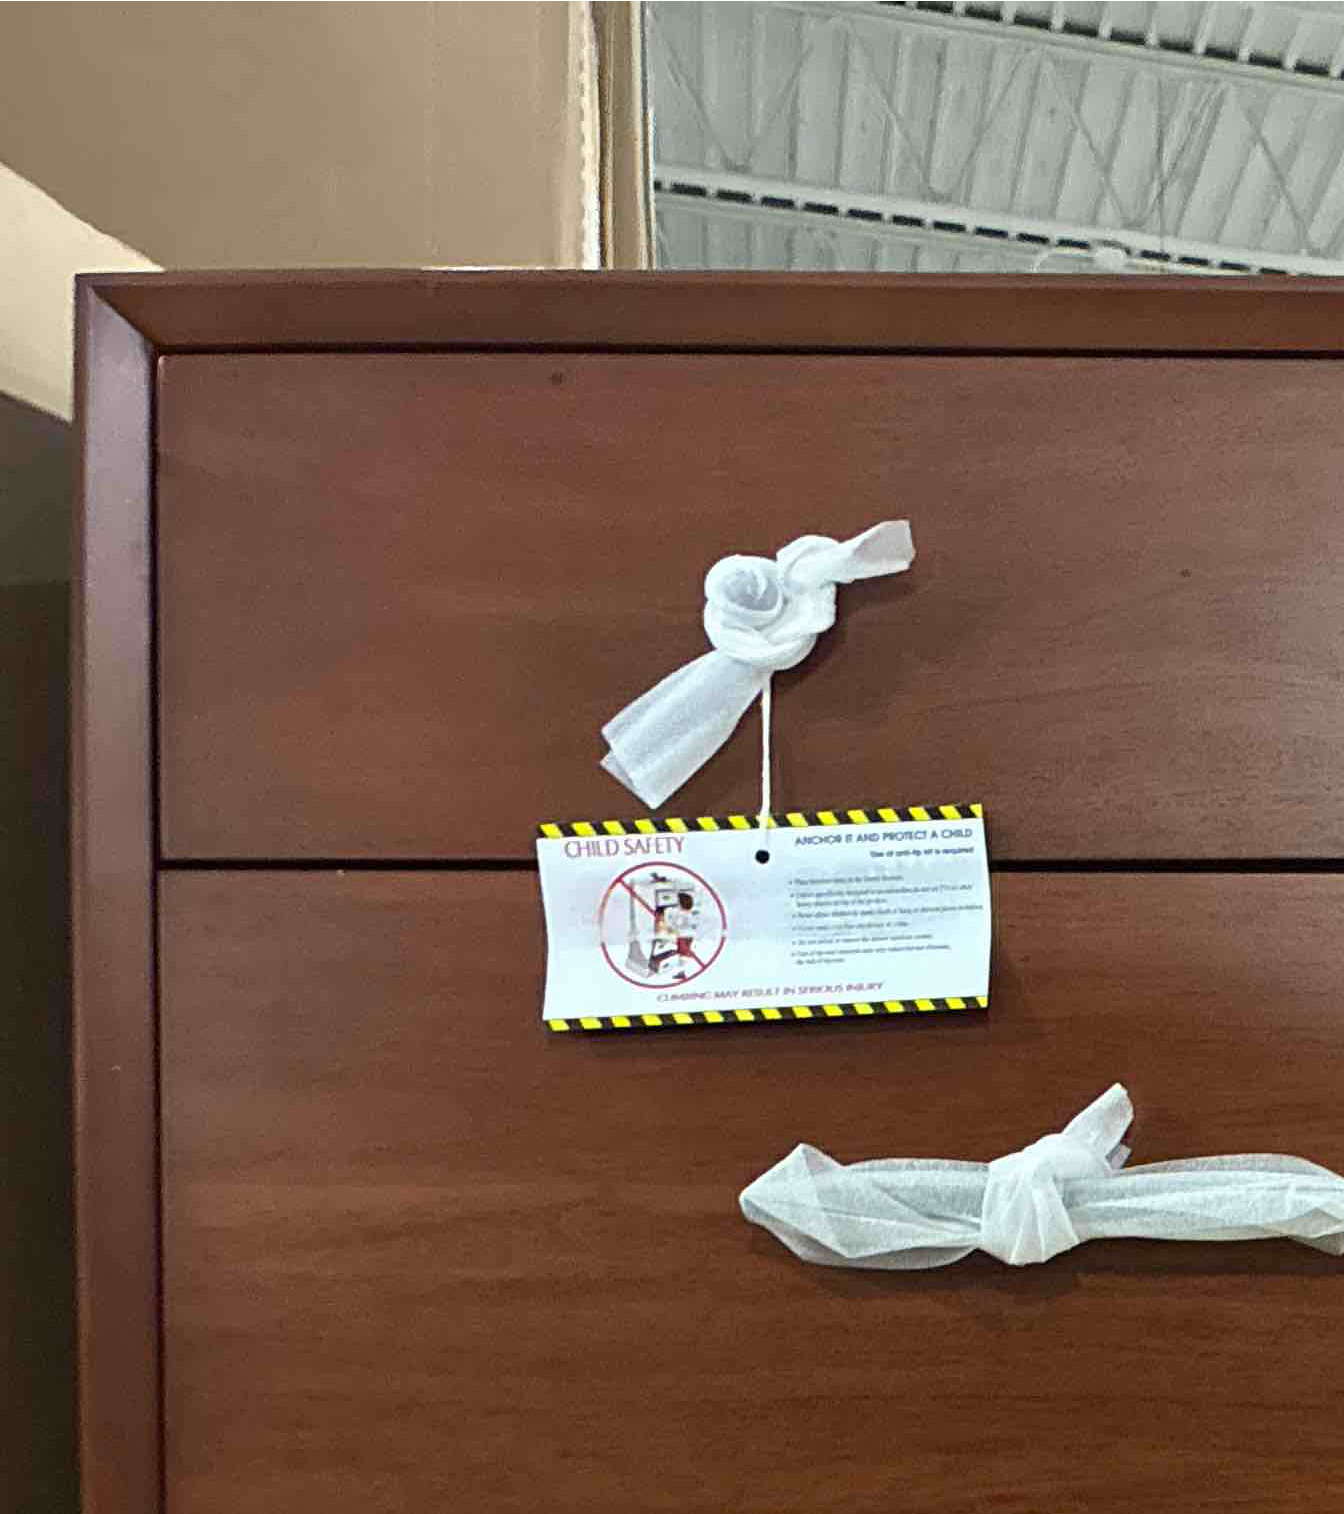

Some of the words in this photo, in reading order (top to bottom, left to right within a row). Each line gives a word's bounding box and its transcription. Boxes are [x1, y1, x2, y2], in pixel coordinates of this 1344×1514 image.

[795, 834, 842, 847] ANCHOR
[856, 832, 880, 843] AND
[882, 829, 927, 841] PROTECT
[930, 829, 938, 839] A
[941, 828, 973, 839] CHILD
[564, 838, 619, 859] CHILD
[623, 836, 685, 856] SAFETY
[714, 988, 738, 999] MAY
